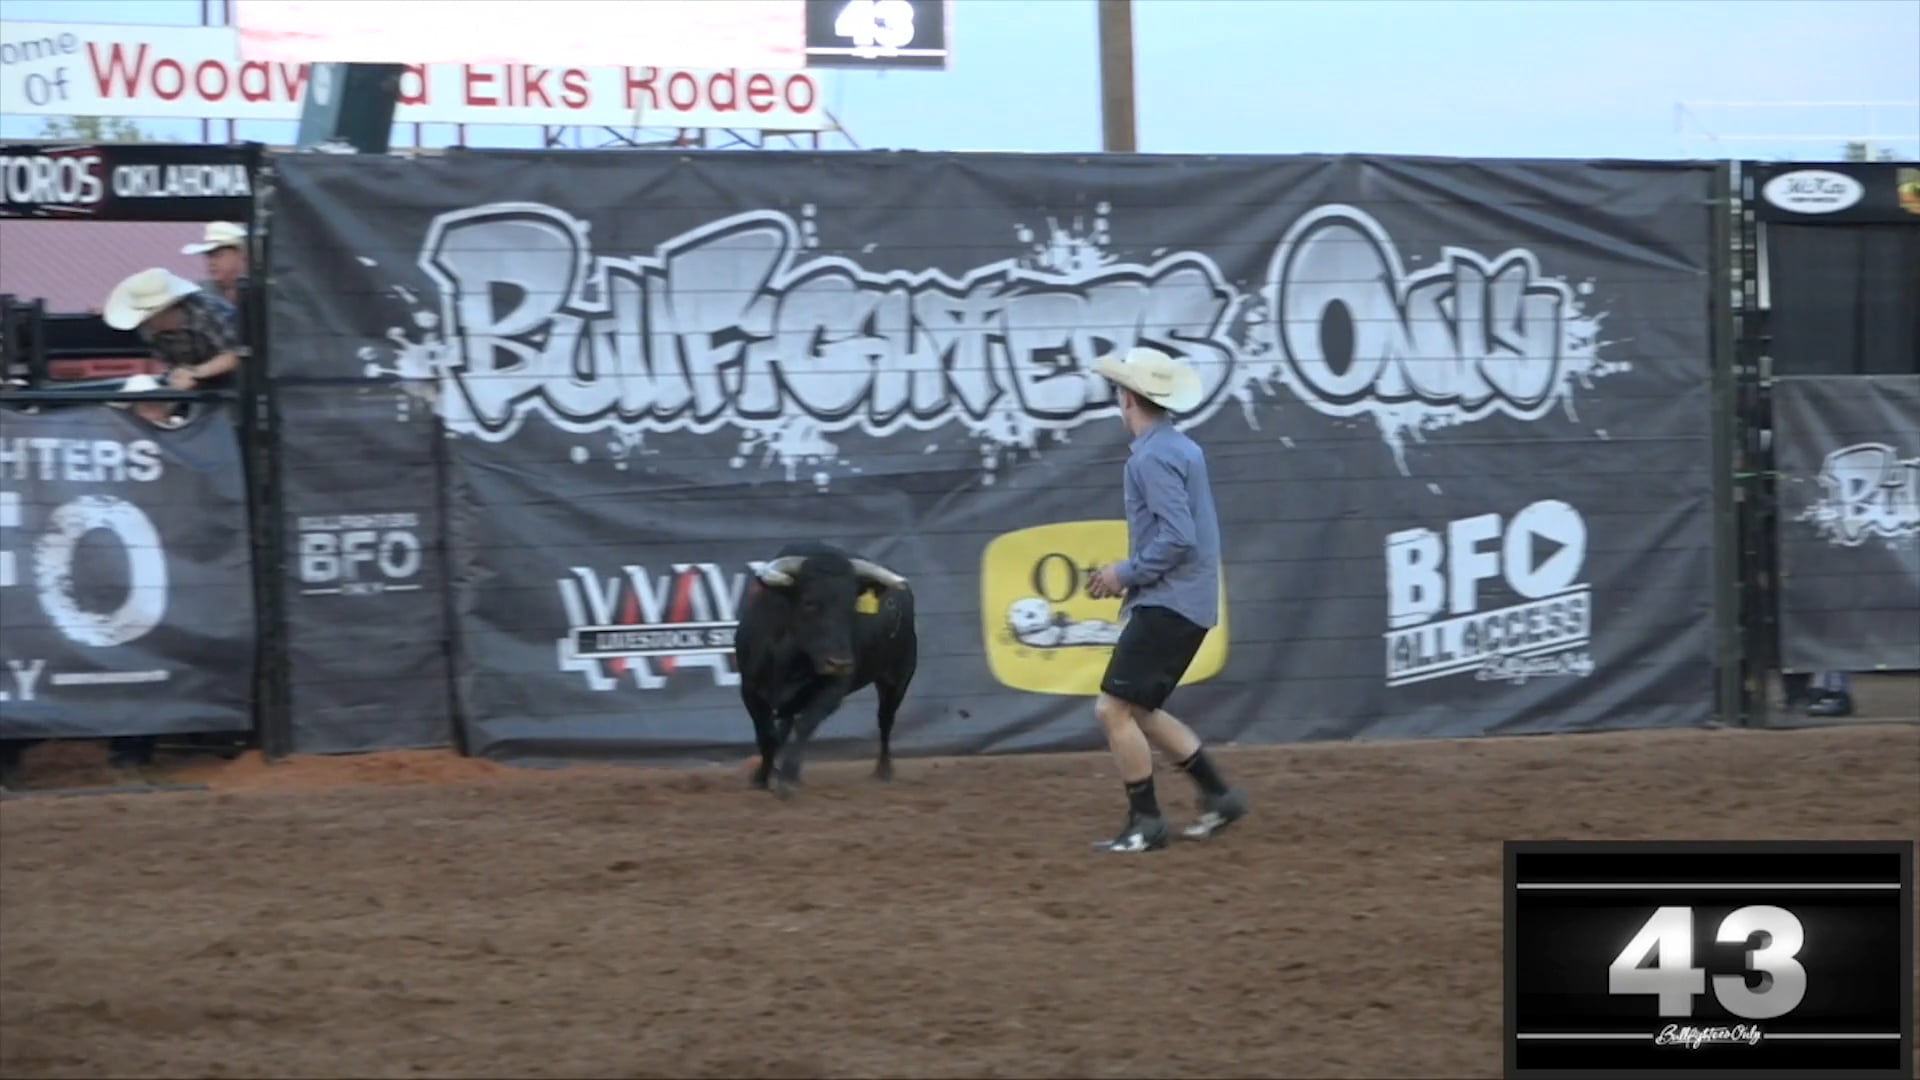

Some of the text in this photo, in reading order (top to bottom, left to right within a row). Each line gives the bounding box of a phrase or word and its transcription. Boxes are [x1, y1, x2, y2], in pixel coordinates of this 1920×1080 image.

[834, 0, 915, 47] 43
[0, 32, 77, 65] ome
[24, 66, 69, 107] Of
[86, 41, 815, 114] Woodwd Elks Rodeo
[113, 164, 251, 198] OKLAHOMA
[300, 531, 421, 583] BFO
[1386, 499, 1587, 629] BFO
[1394, 625, 1454, 669] ALL
[1462, 597, 1584, 656] ACCESS
